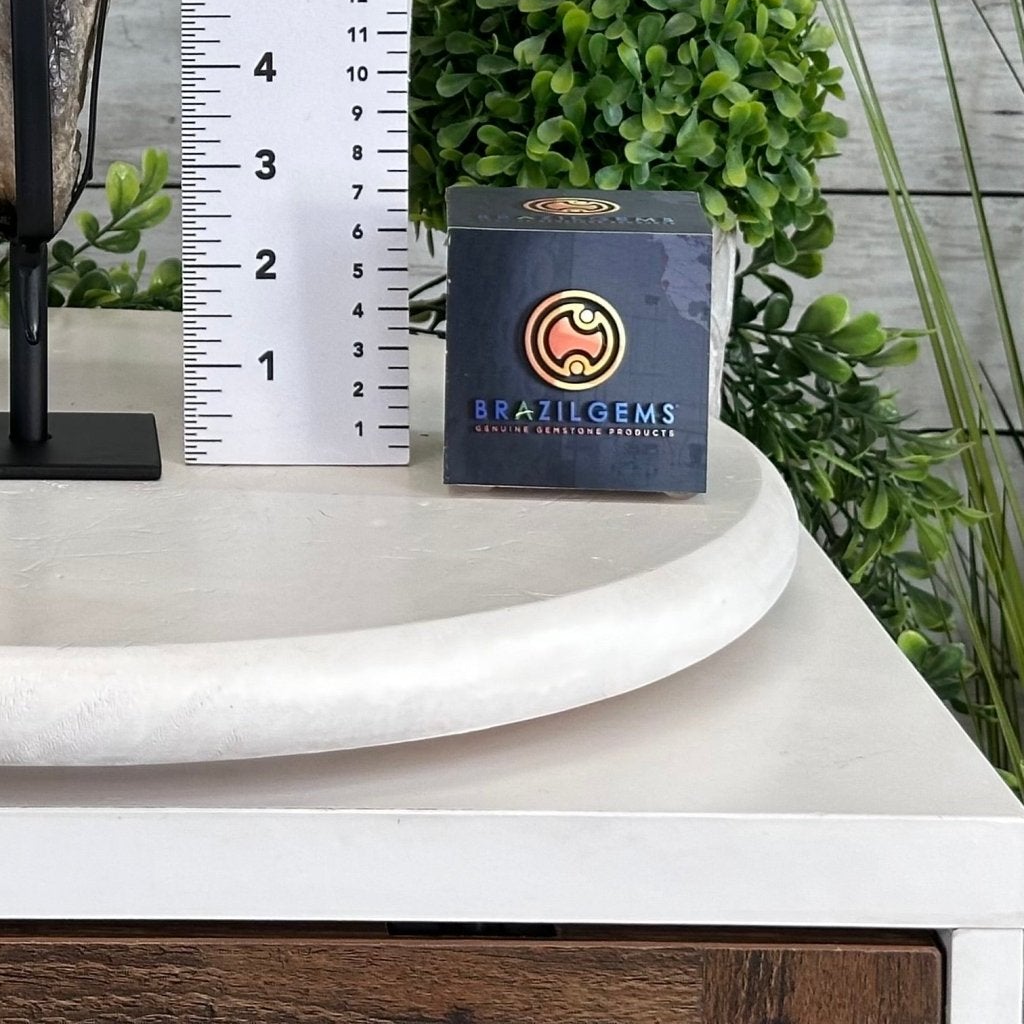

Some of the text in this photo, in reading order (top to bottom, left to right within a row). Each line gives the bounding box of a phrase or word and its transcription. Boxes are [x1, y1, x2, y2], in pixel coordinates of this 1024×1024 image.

[347, 26, 367, 43] 11
[253, 51, 277, 83] 4
[346, 65, 369, 82] 10
[351, 105, 363, 122] 9
[352, 144, 363, 161] 8
[254, 148, 277, 181] 3
[351, 184, 364, 200] 7
[351, 223, 364, 240] 6
[255, 248, 277, 280] 2
[352, 262, 364, 279] 5
[351, 302, 365, 319] 4
[352, 341, 364, 358] 3
[258, 350, 274, 381] 1
[352, 381, 364, 398] 2
[474, 399, 676, 425] BRAZILGEMS
[354, 420, 363, 437] 1
[475, 425, 675, 438] GENUINE GEMSTONE PRODUCTS
